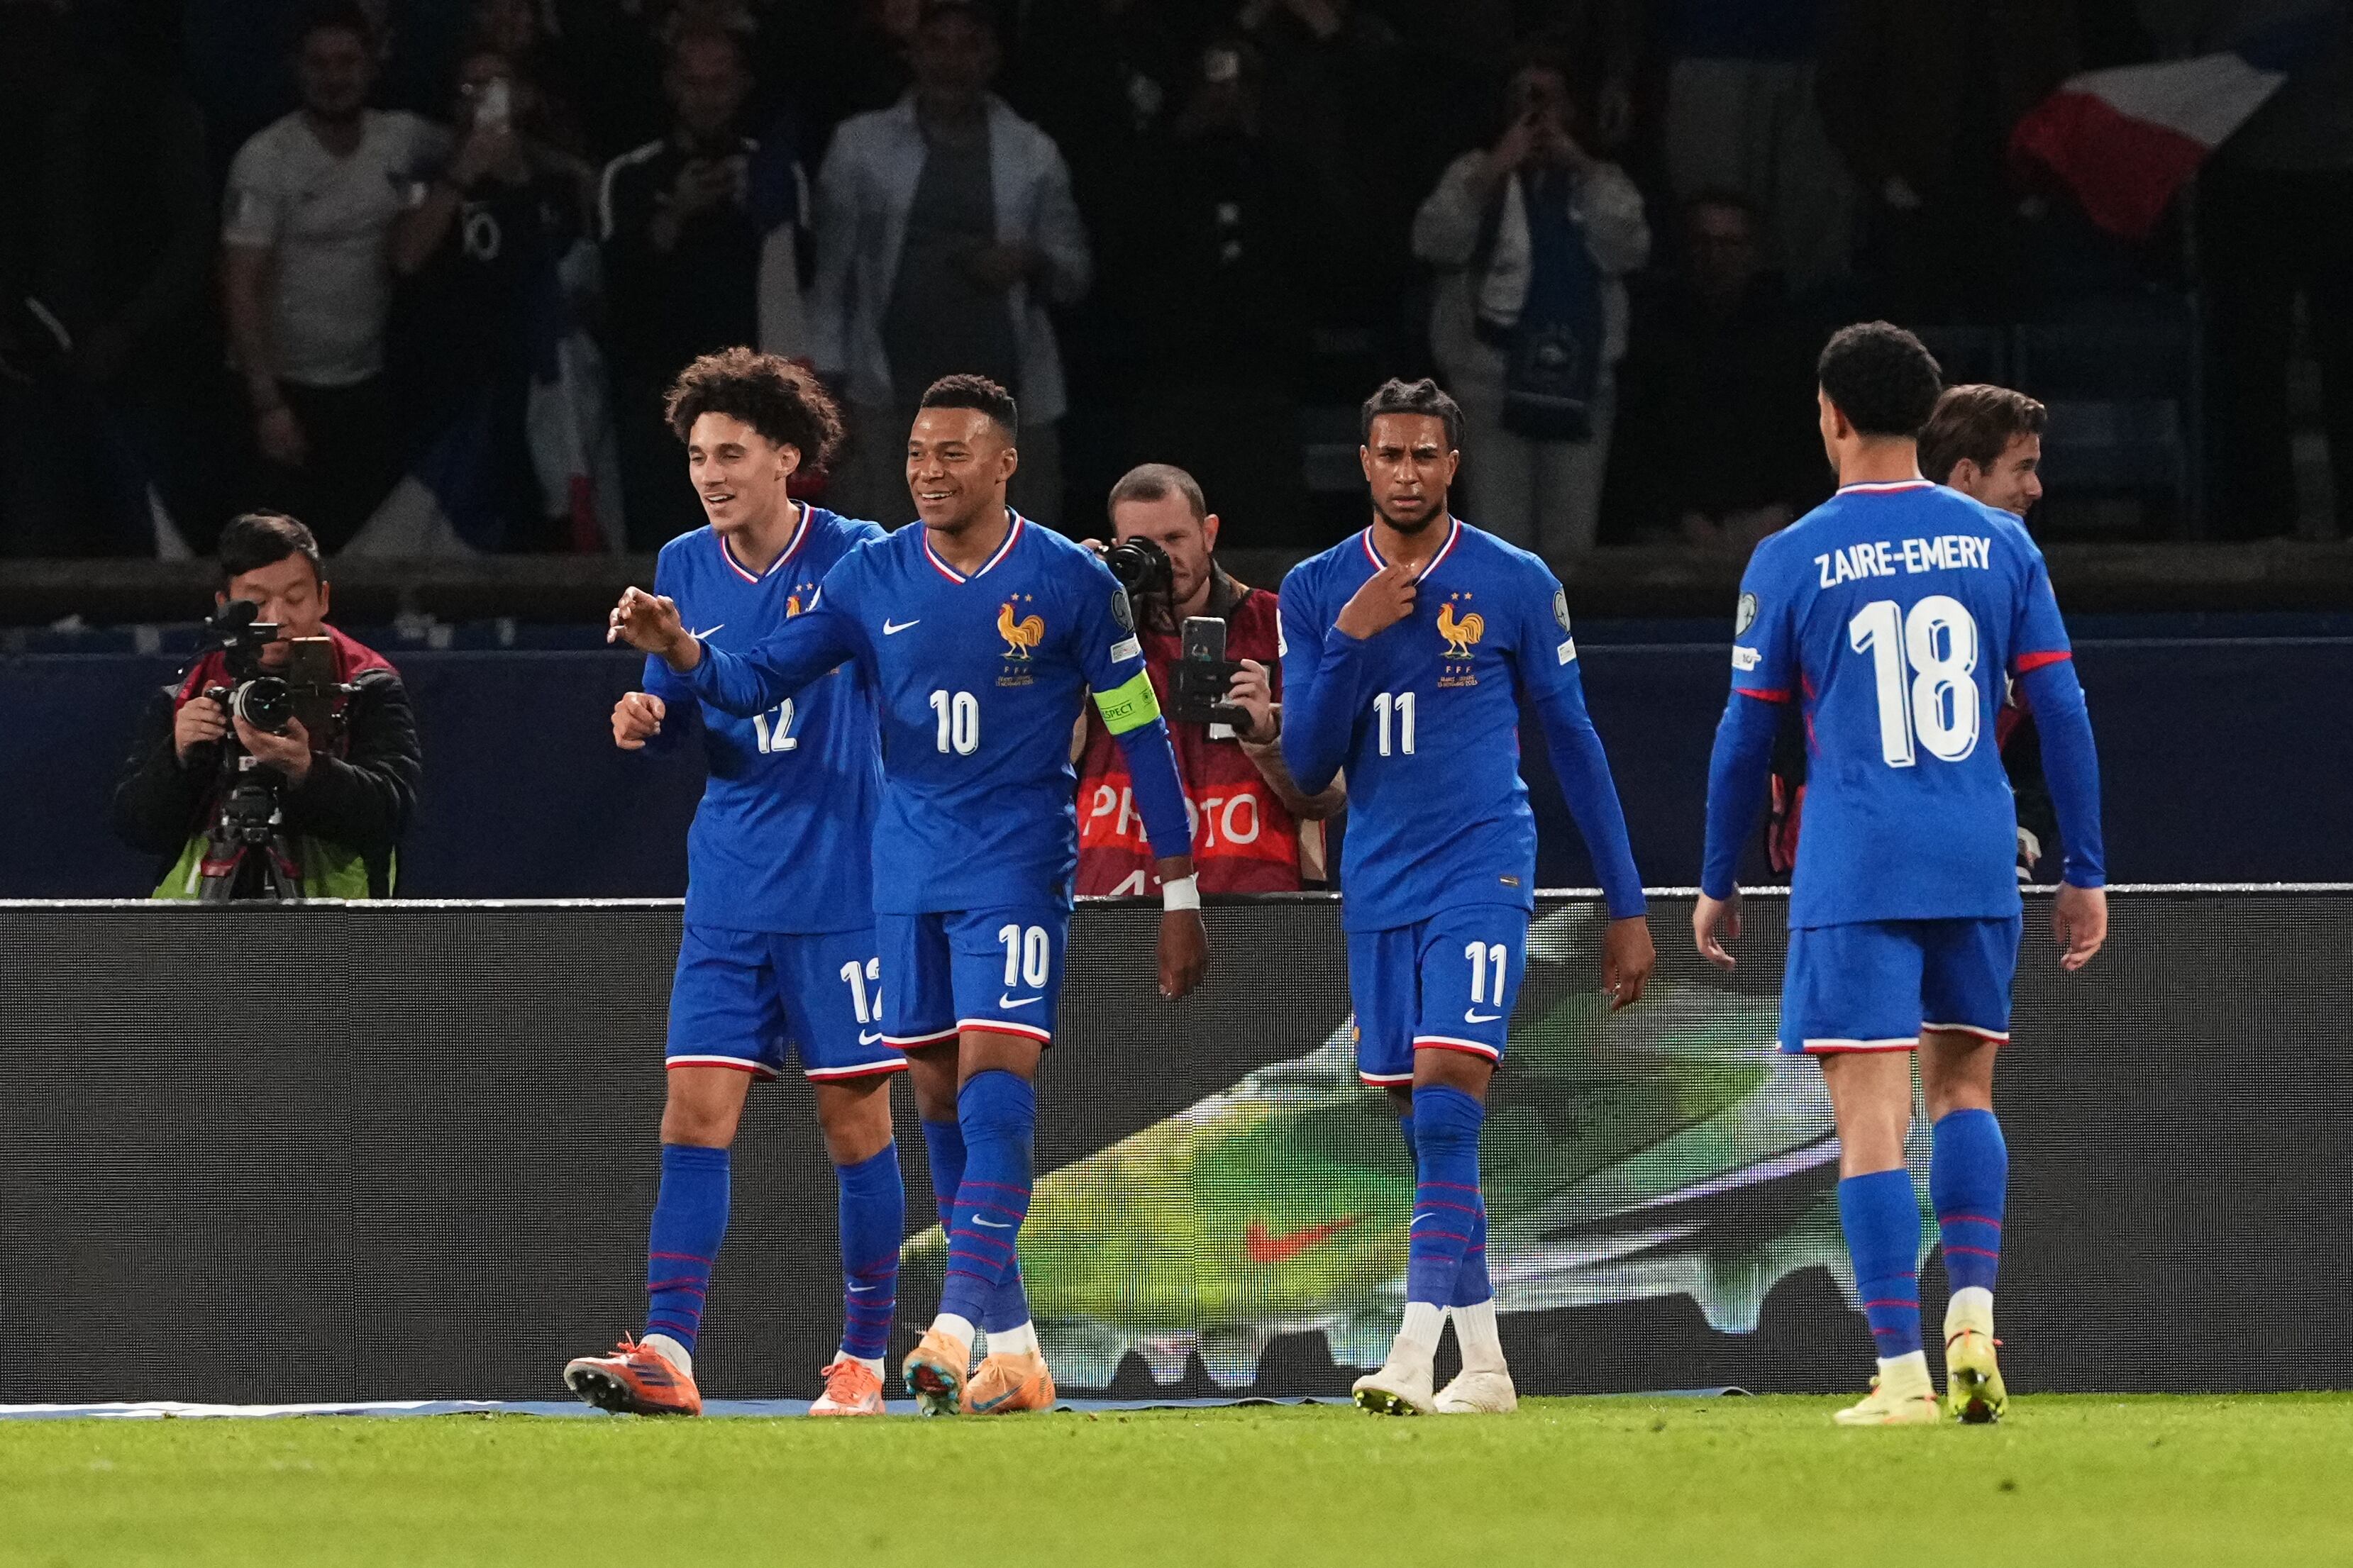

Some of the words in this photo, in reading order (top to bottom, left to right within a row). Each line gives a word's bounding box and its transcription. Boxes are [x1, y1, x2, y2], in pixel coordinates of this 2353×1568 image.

[1815, 535, 1991, 589] ZAIRE-EMERY
[1849, 594, 1980, 767] 18
[753, 697, 797, 754] 12
[930, 689, 979, 755] 10
[1373, 691, 1415, 756] 11
[999, 924, 1050, 988] 10
[1465, 941, 1507, 1007] 11
